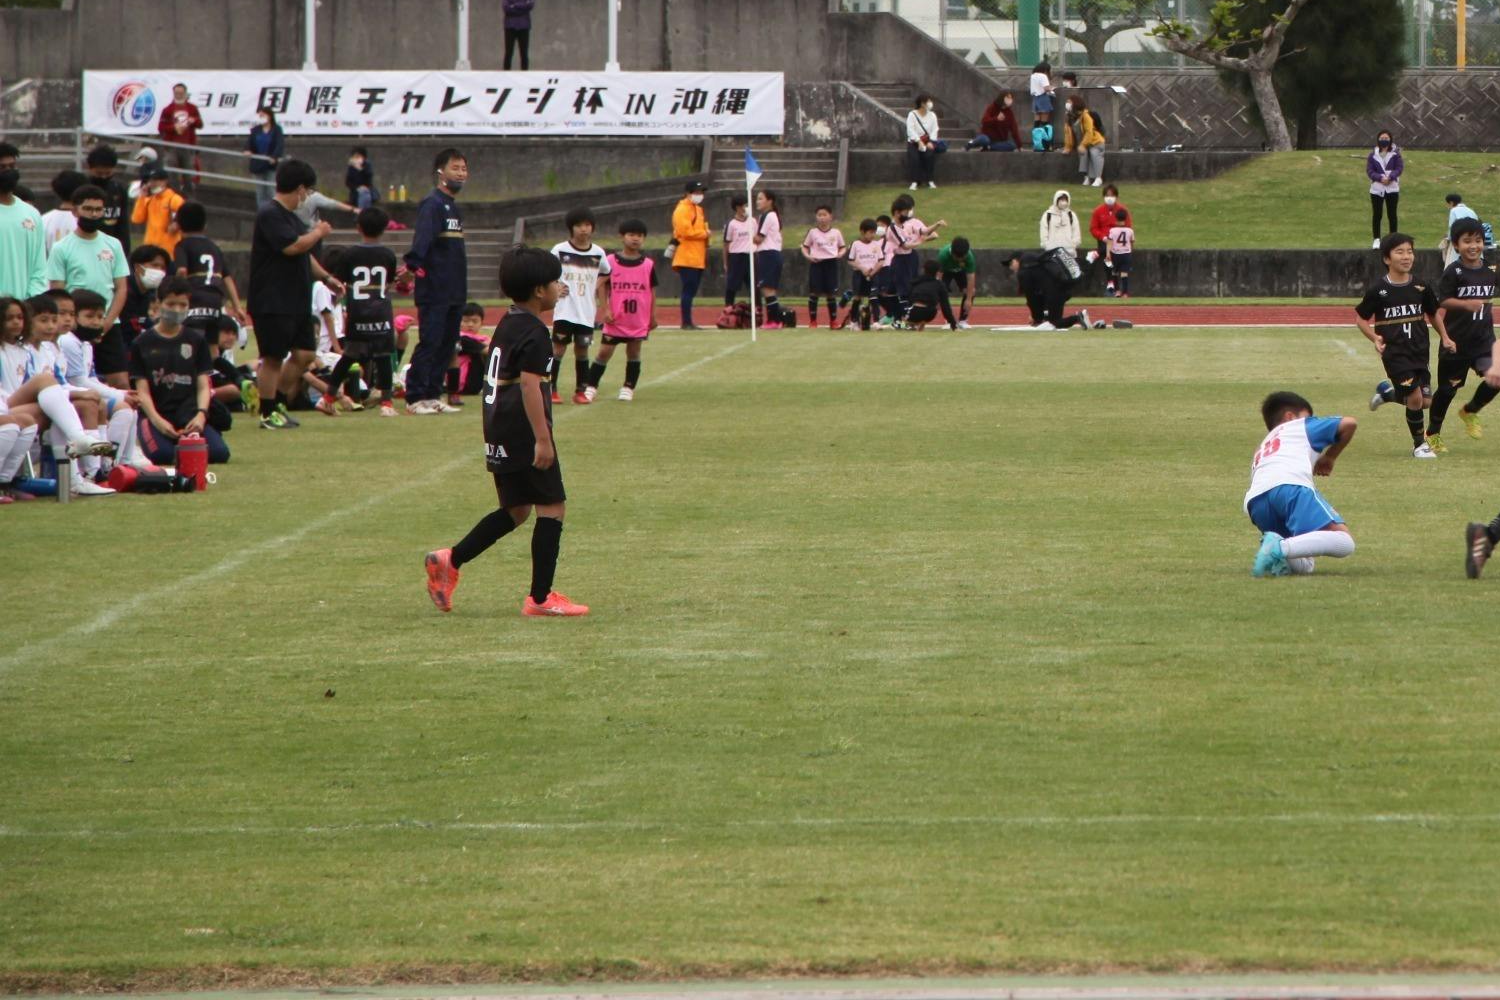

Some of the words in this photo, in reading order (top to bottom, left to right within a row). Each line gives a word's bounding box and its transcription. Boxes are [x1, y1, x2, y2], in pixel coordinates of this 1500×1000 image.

[187, 92, 239, 108] 3回
[256, 78, 608, 115] 国際チャレンジ杯
[624, 93, 656, 115] IN
[670, 87, 750, 115] 沖縄
[1116, 231, 1127, 246] 4
[352, 266, 387, 300] 27
[622, 299, 637, 314] 10
[355, 321, 391, 332] ZELVA
[1403, 322, 1412, 339] 4
[485, 346, 501, 404] 9
